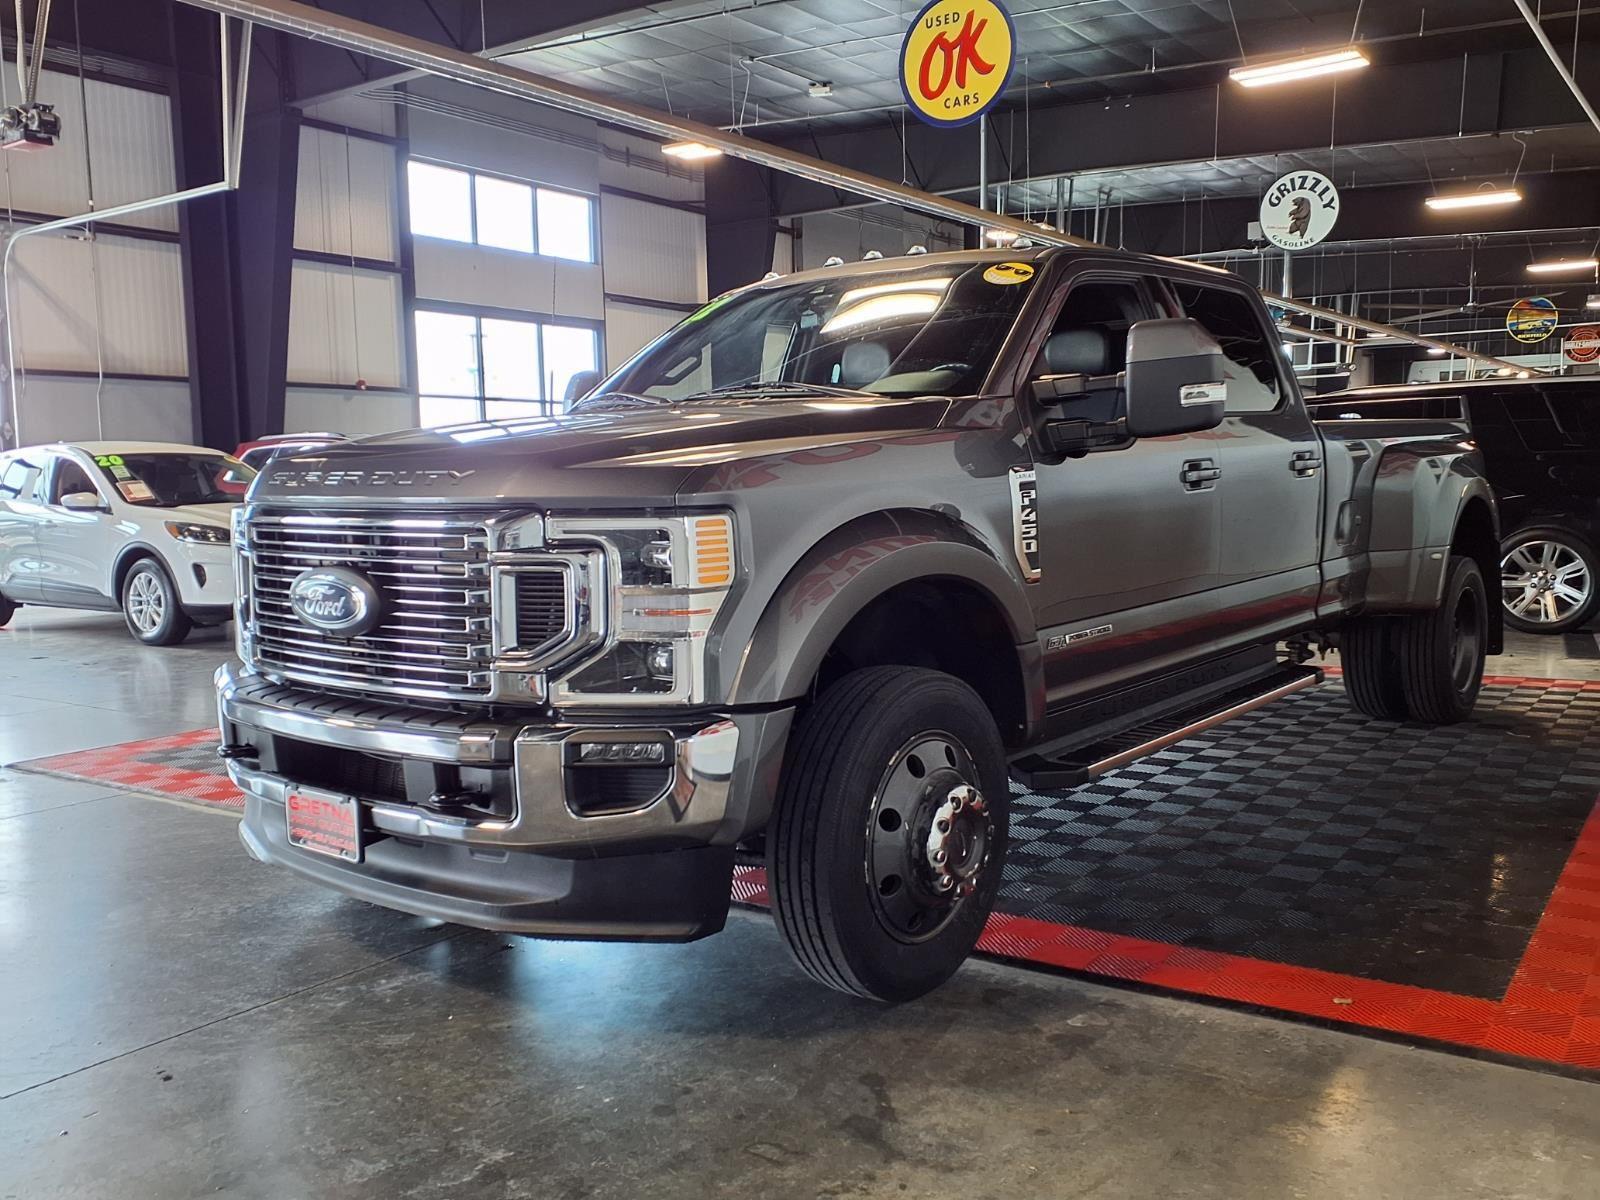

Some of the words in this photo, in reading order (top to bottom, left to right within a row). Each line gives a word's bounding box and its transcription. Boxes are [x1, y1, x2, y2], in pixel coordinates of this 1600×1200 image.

[925, 12, 960, 29] USED
[918, 9, 996, 100] OK
[943, 92, 980, 109] CARS
[1268, 175, 1336, 211] GRIZZLY
[1272, 234, 1315, 247] GASOLINE
[94, 455, 124, 467] 20
[268, 471, 364, 487] SUPER
[370, 469, 476, 487] DUTY
[303, 585, 346, 617] Ford
[288, 796, 353, 825] GRETNA
